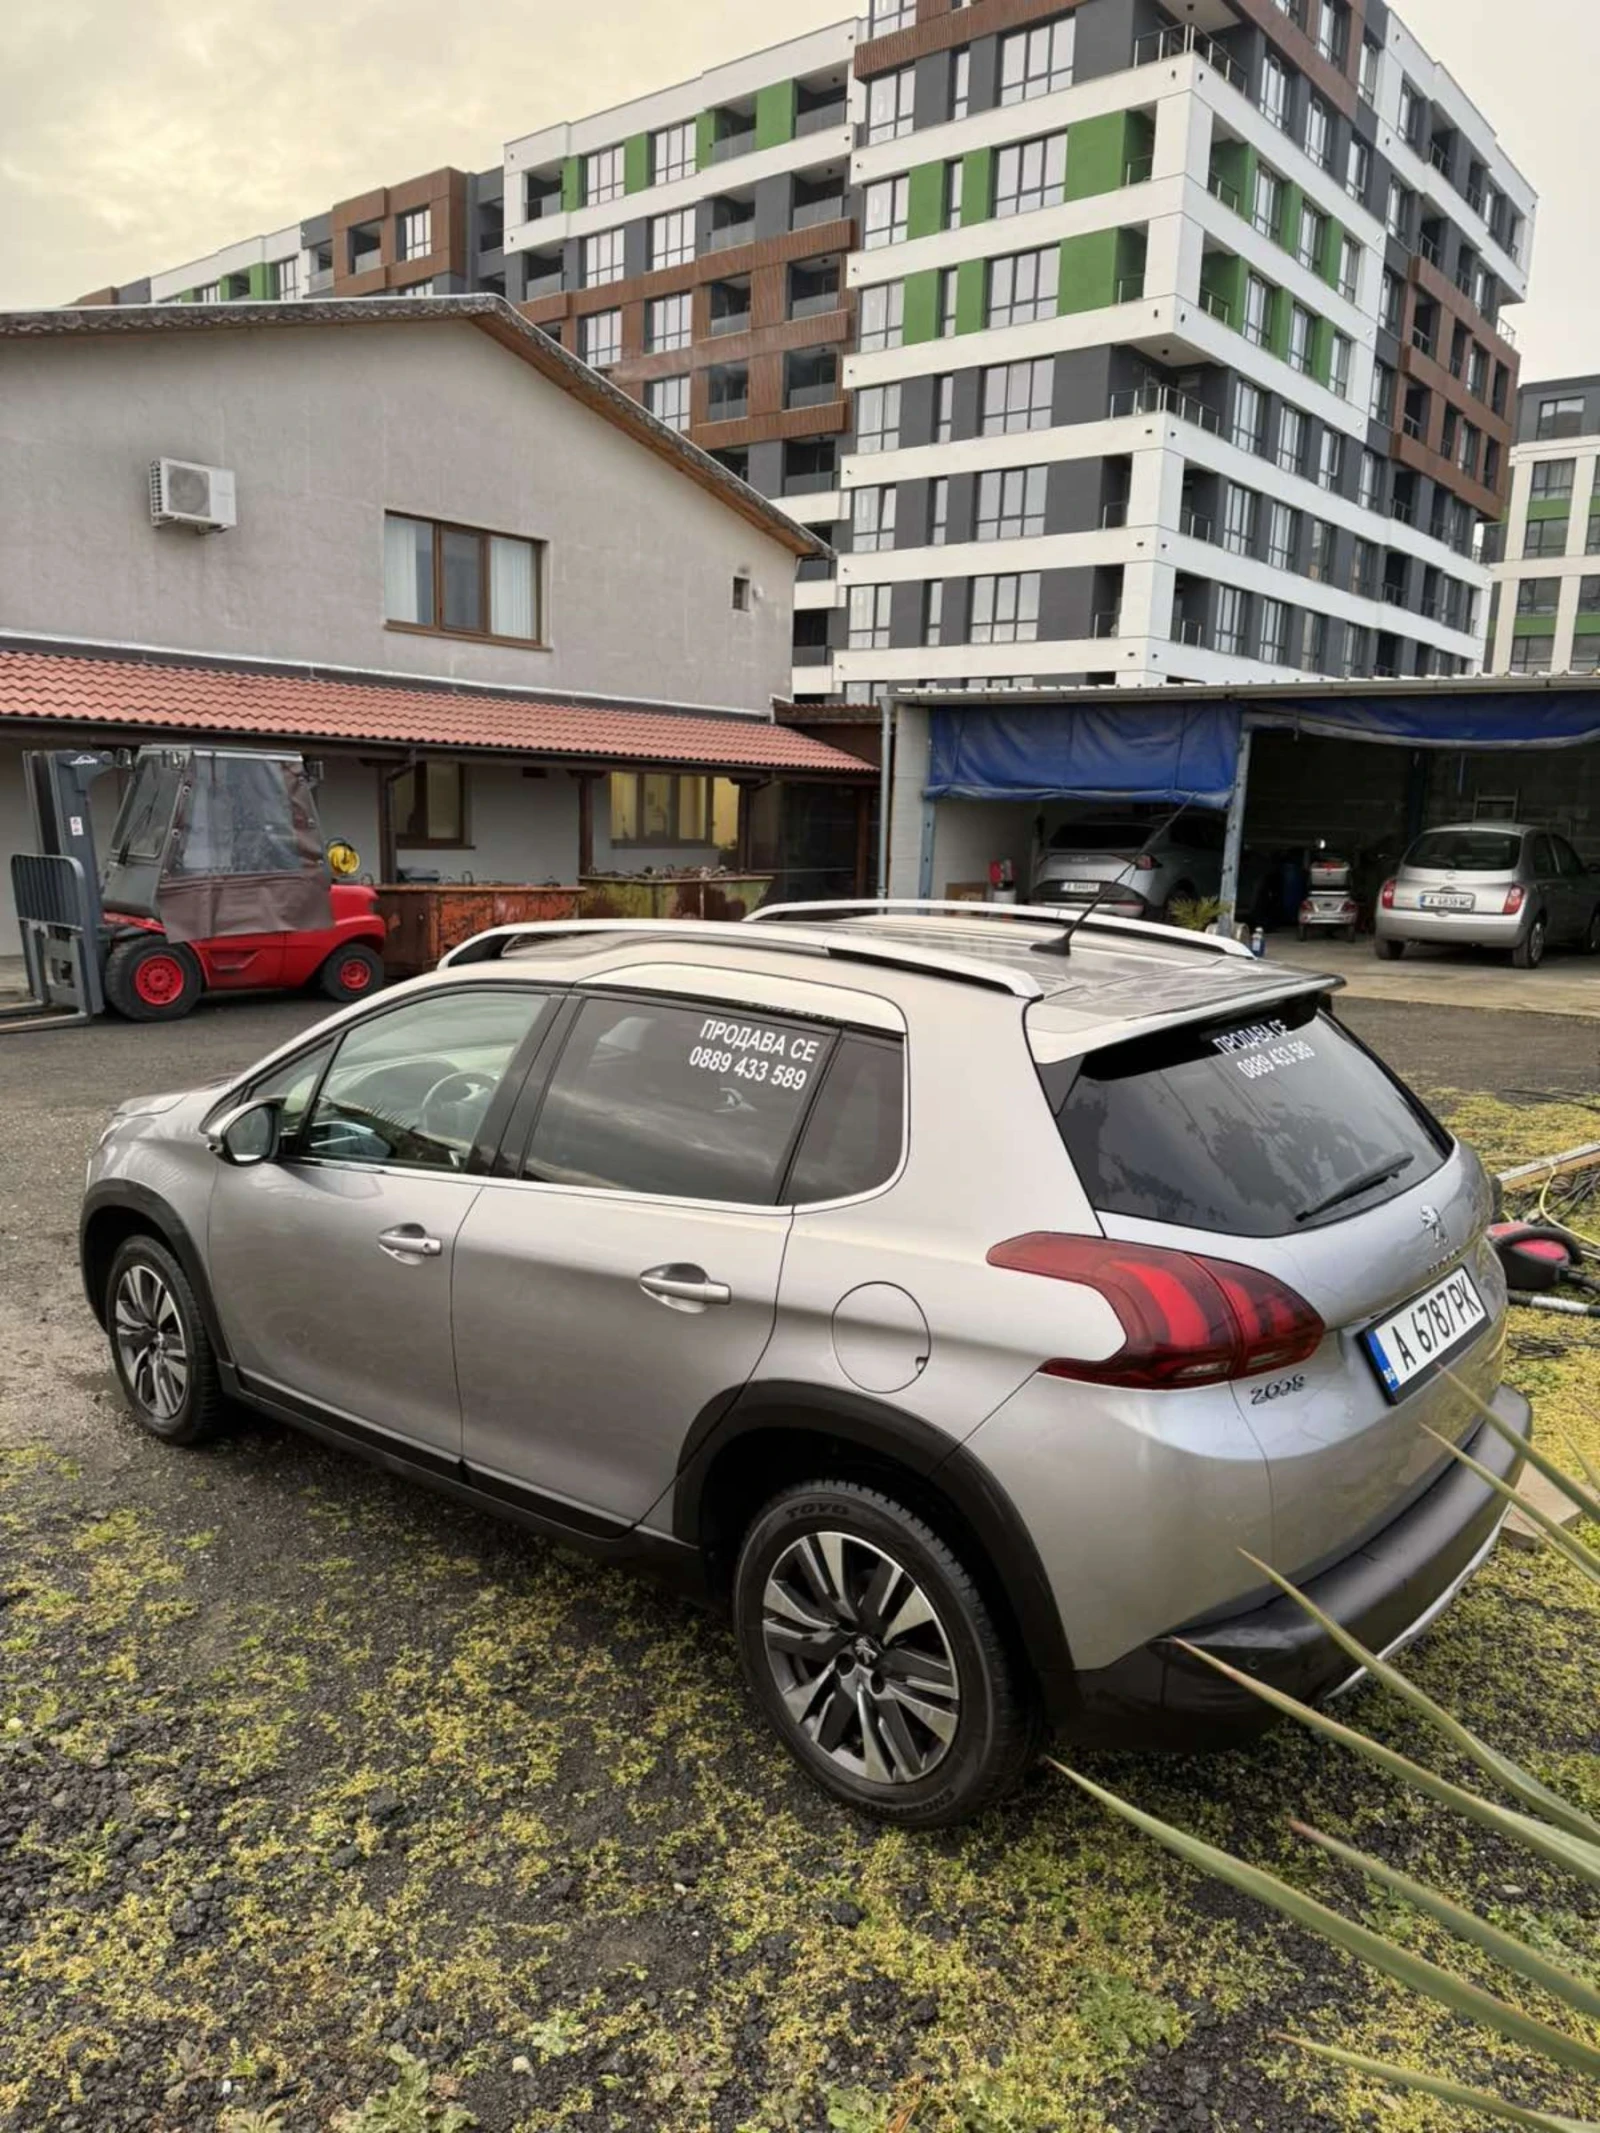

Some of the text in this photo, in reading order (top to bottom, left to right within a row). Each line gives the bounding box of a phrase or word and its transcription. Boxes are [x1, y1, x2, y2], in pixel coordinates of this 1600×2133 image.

[700, 1019, 820, 1062] ПРОДАВА СЕ
[1212, 1023, 1276, 1056] ПРОДАВА
[689, 1046, 808, 1091] 0889 433 589
[1236, 1053, 1275, 1079] 0889
[1268, 1045, 1297, 1067] 433
[1391, 1325, 1417, 1371] A
[1250, 1373, 1306, 1405] 2008
[785, 1502, 850, 1519] TOYO
